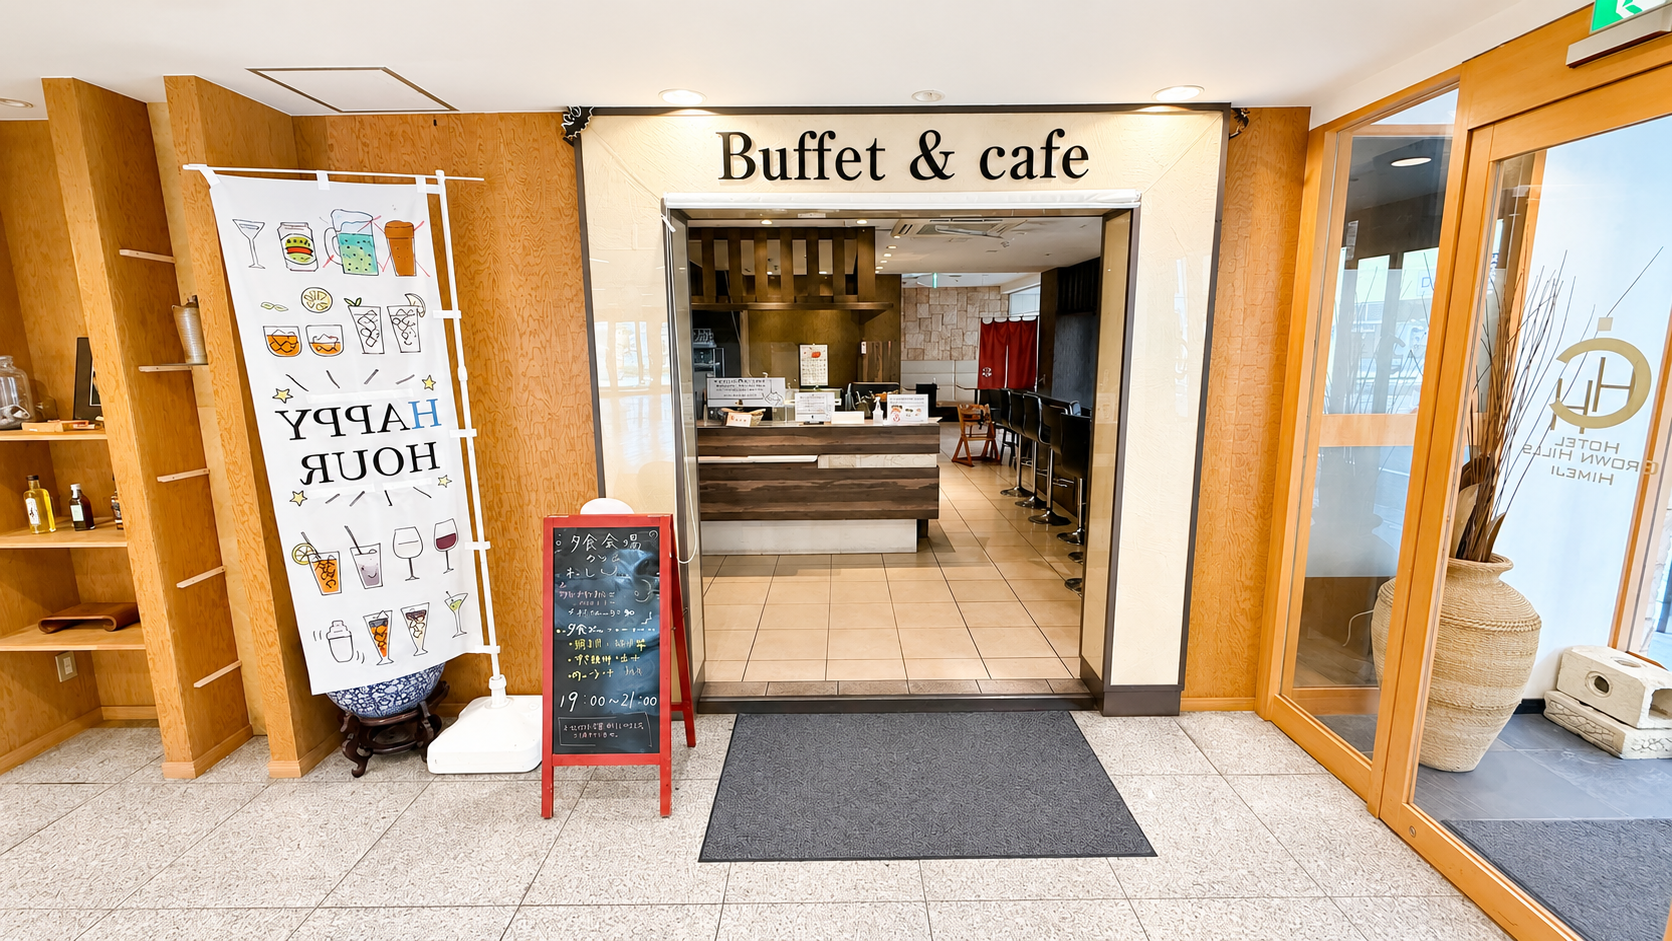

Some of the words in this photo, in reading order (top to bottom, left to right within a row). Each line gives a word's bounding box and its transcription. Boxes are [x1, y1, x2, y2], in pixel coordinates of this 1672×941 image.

[715, 129, 887, 182] Buffet
[909, 129, 956, 181] &
[978, 128, 1090, 181] cafe
